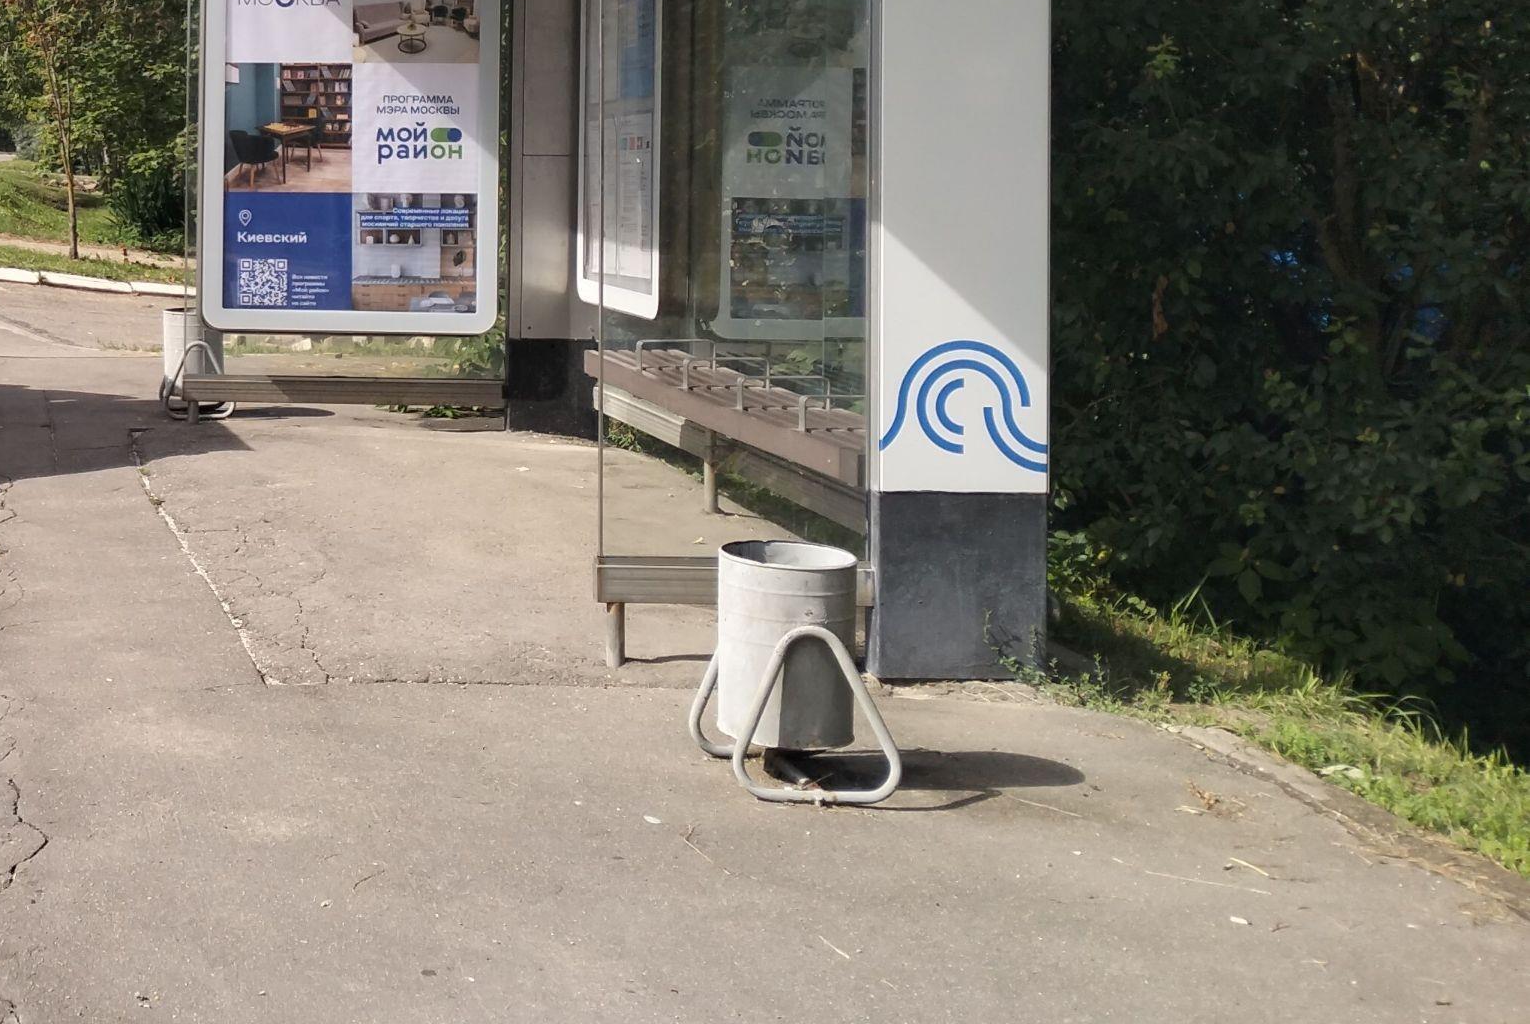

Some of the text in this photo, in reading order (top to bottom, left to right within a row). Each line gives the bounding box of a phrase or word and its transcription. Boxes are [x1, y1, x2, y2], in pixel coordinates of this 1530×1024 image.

[382, 95, 454, 104] ПРОГРАММА
[376, 106, 460, 115] МЭРА МОСКВЫ
[376, 121, 428, 142] мой
[237, 231, 308, 243] Киевский
